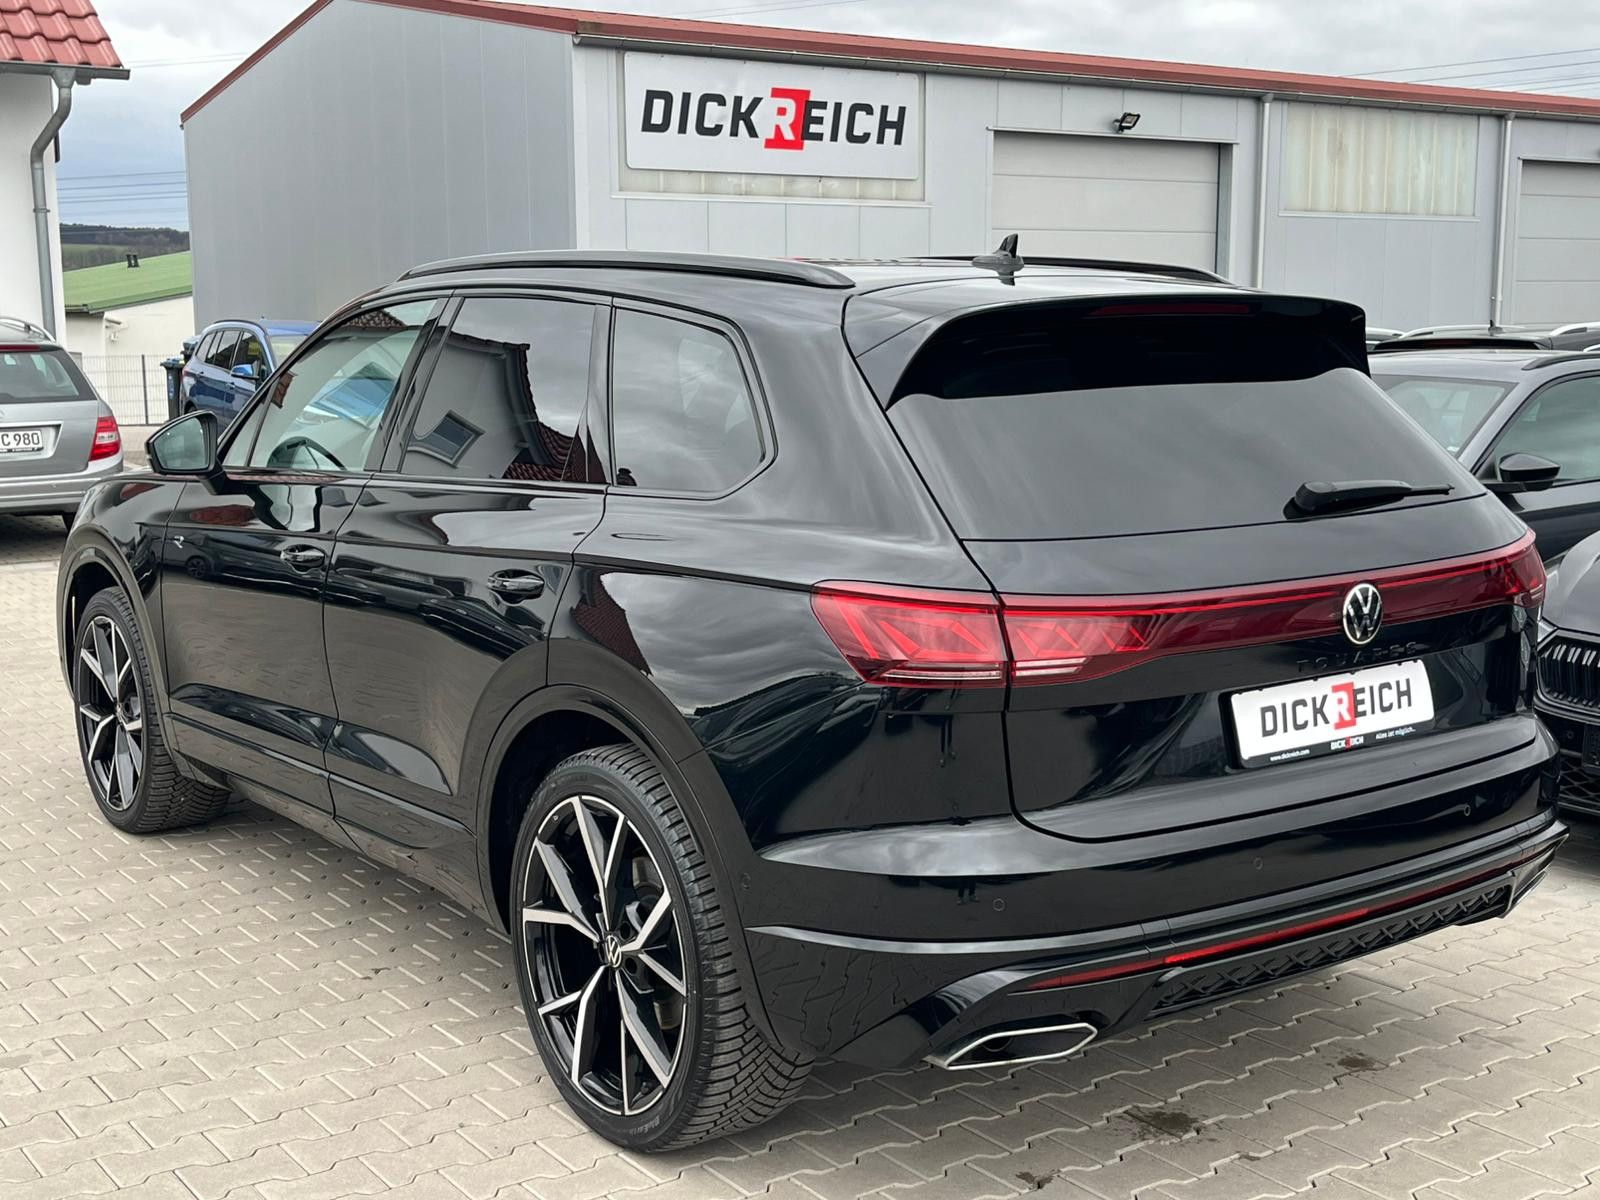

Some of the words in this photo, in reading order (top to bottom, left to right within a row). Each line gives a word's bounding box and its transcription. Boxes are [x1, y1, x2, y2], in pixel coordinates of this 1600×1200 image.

[641, 87, 907, 150] DICKREICH
[1, 433, 10, 446] C
[13, 432, 40, 446] 980
[1259, 677, 1413, 738] DICKREICH
